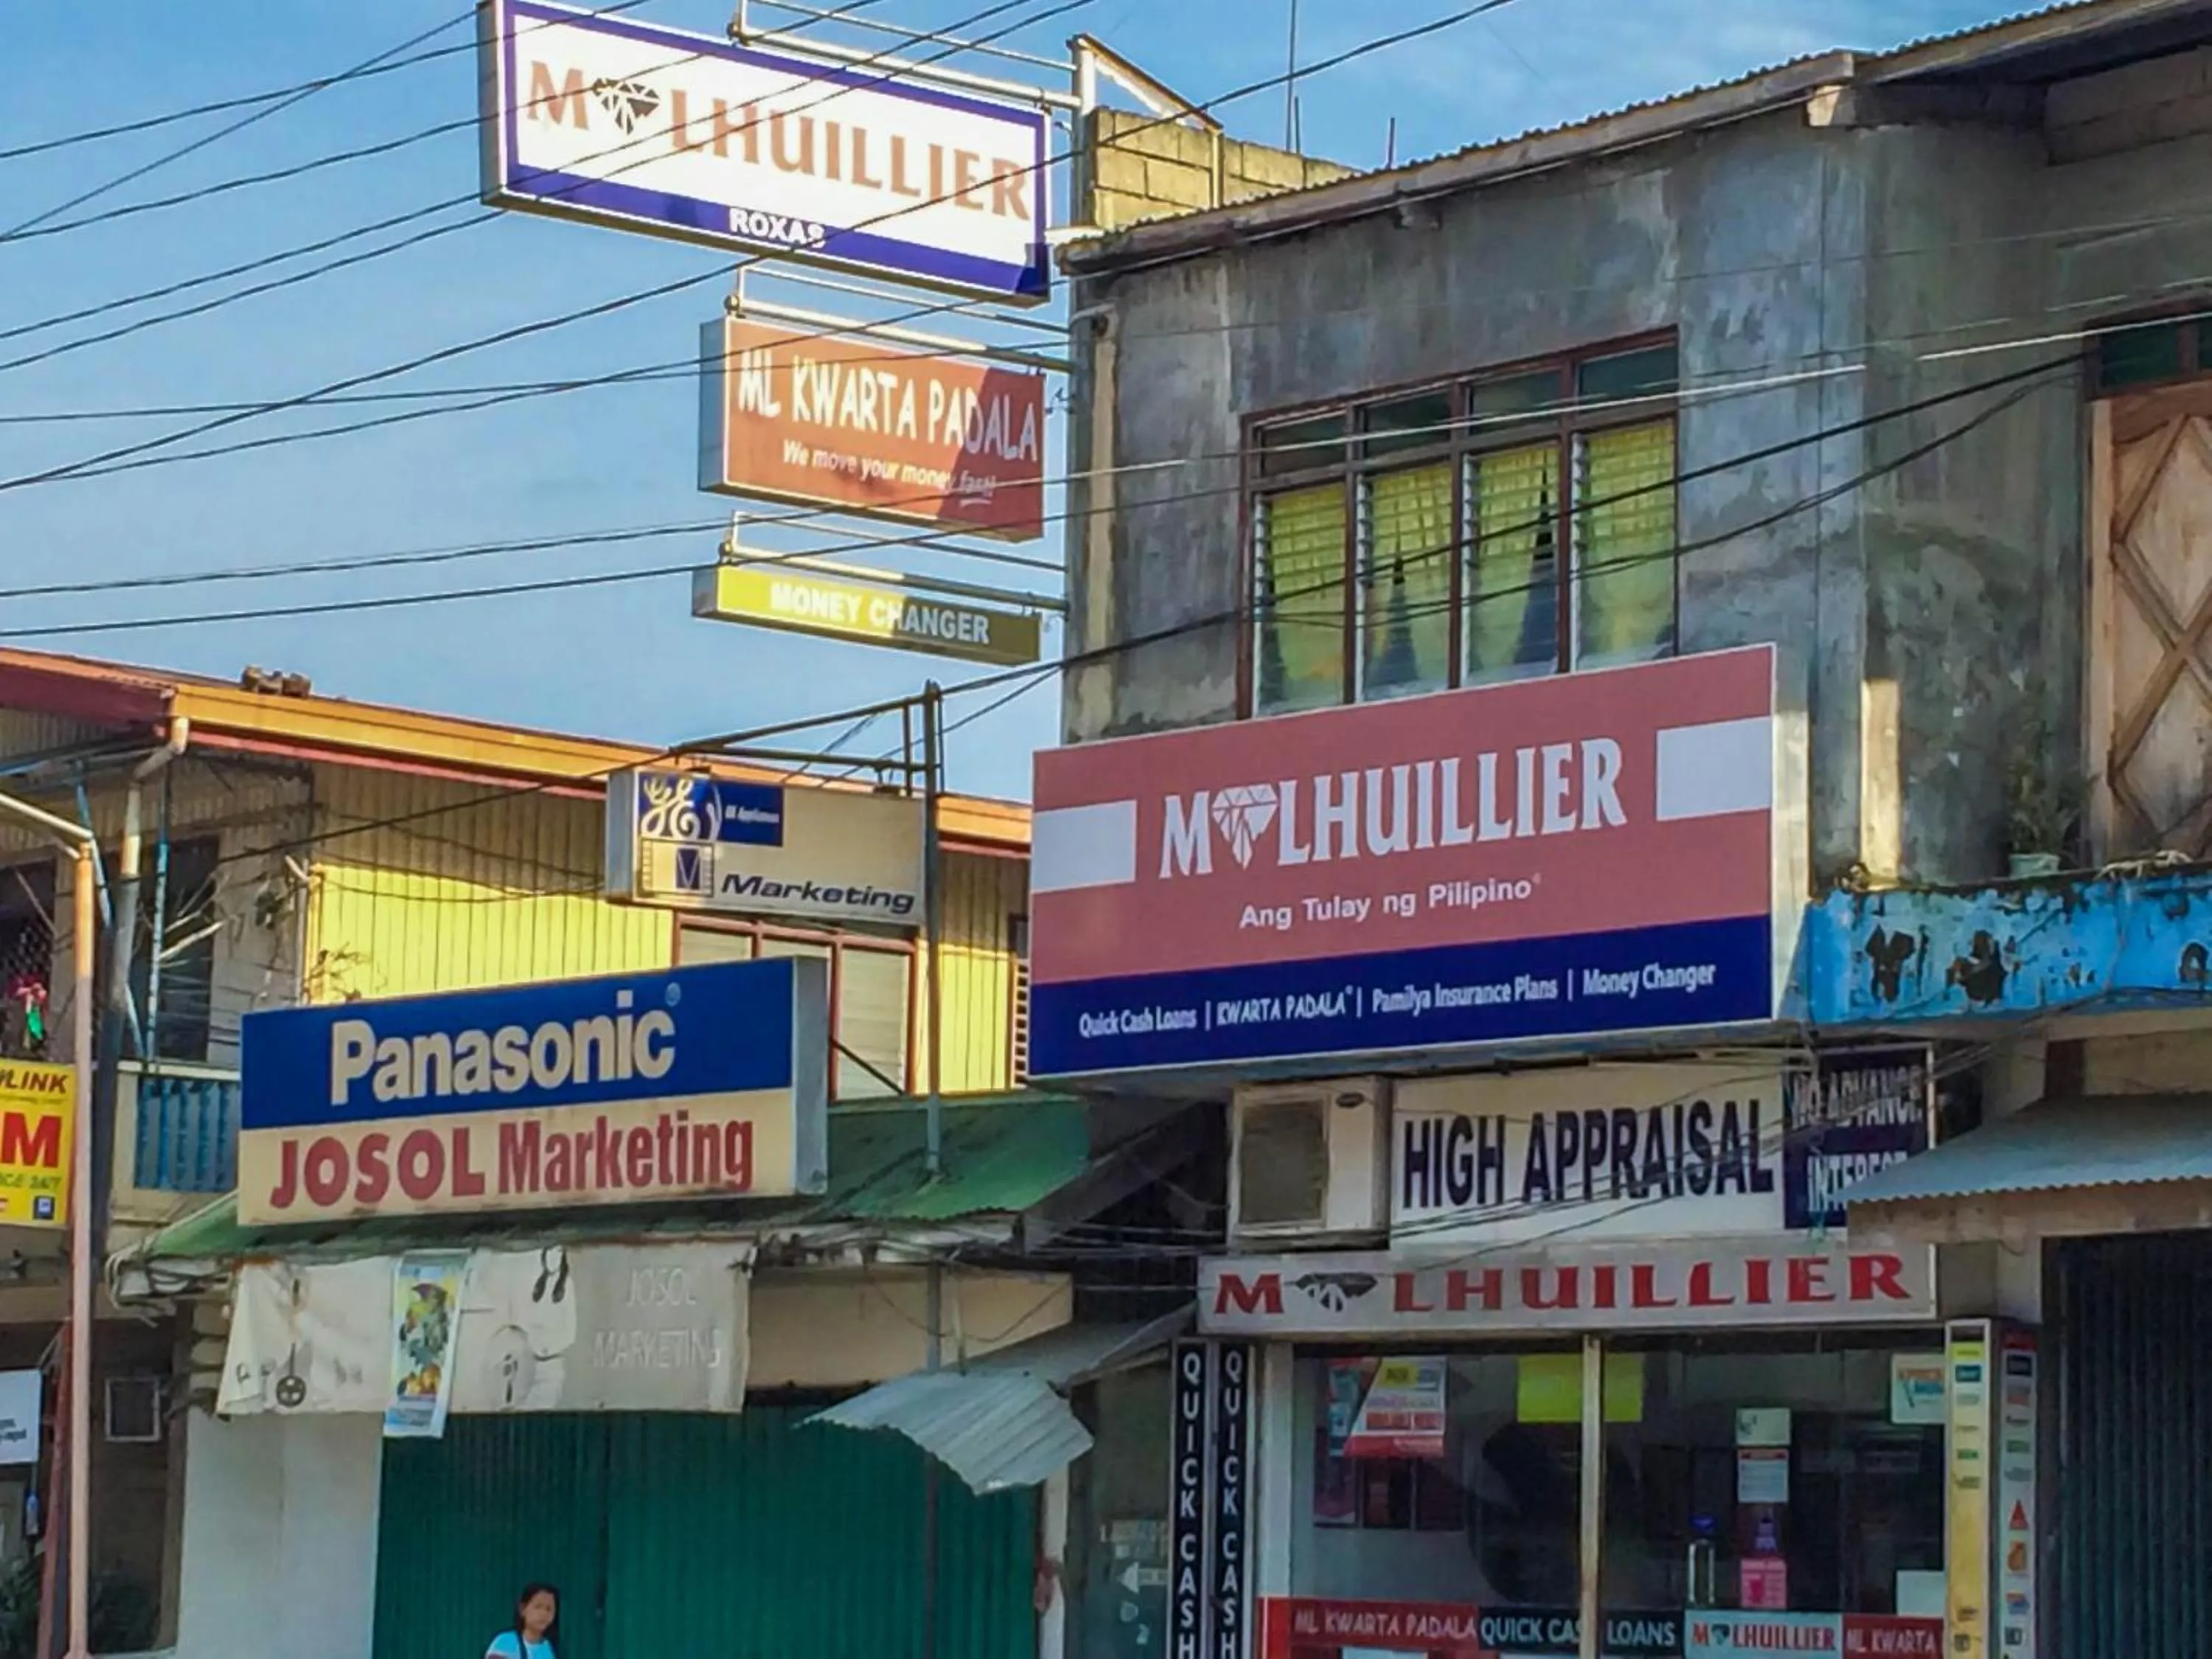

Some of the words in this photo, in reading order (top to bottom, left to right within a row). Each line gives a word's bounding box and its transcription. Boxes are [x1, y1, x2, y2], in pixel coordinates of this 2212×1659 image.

[669, 88, 1031, 221] LHUILLIER
[728, 207, 827, 249] ROXAS
[738, 349, 781, 418] ML
[791, 355, 917, 440] KWARTA
[928, 379, 1038, 462] PADALA
[782, 439, 810, 466] We
[812, 448, 857, 473] move
[860, 456, 898, 481] your
[901, 464, 954, 492] money
[771, 582, 862, 625] MONEY
[869, 595, 990, 644] CHANGER
[1276, 737, 1627, 867] LHUILLIER
[721, 873, 916, 914] Marketing
[1239, 904, 1292, 931] Ang
[1302, 896, 1371, 922] Tulay
[1382, 892, 1416, 917] ng
[1428, 877, 1532, 910] Pilipino
[1079, 1010, 1120, 1039] Quick
[1121, 1007, 1154, 1033] Cash
[1156, 1006, 1197, 1031] Loans
[1217, 998, 1281, 1026] KWARTA
[1285, 991, 1346, 1019] PADALA
[1371, 984, 1431, 1018] Pamilya
[1435, 981, 1511, 1007] Insurance
[1514, 974, 1558, 1001] Plans
[1582, 967, 1640, 998] Money
[1642, 961, 1717, 992] Changer
[330, 990, 676, 1105] Panasonic
[269, 1127, 485, 1209] JOSOL
[498, 1110, 754, 1194] Marketing
[1402, 1114, 1506, 1209] HIGH
[1521, 1098, 1775, 1206] APPRAISAL
[1391, 1253, 1912, 1313] LHUILLIER
[1180, 1352, 1202, 1518] QUICK
[1222, 1350, 1242, 1516] QUICK
[1326, 1613, 1400, 1637] KWARTA
[1405, 1613, 1478, 1640] PADALA
[1480, 1617, 1544, 1645] QUICK
[1606, 1620, 1677, 1648] LOANS
[1733, 1624, 1837, 1652] LHUILLIER
[1871, 1628, 1936, 1654] KWARTA
